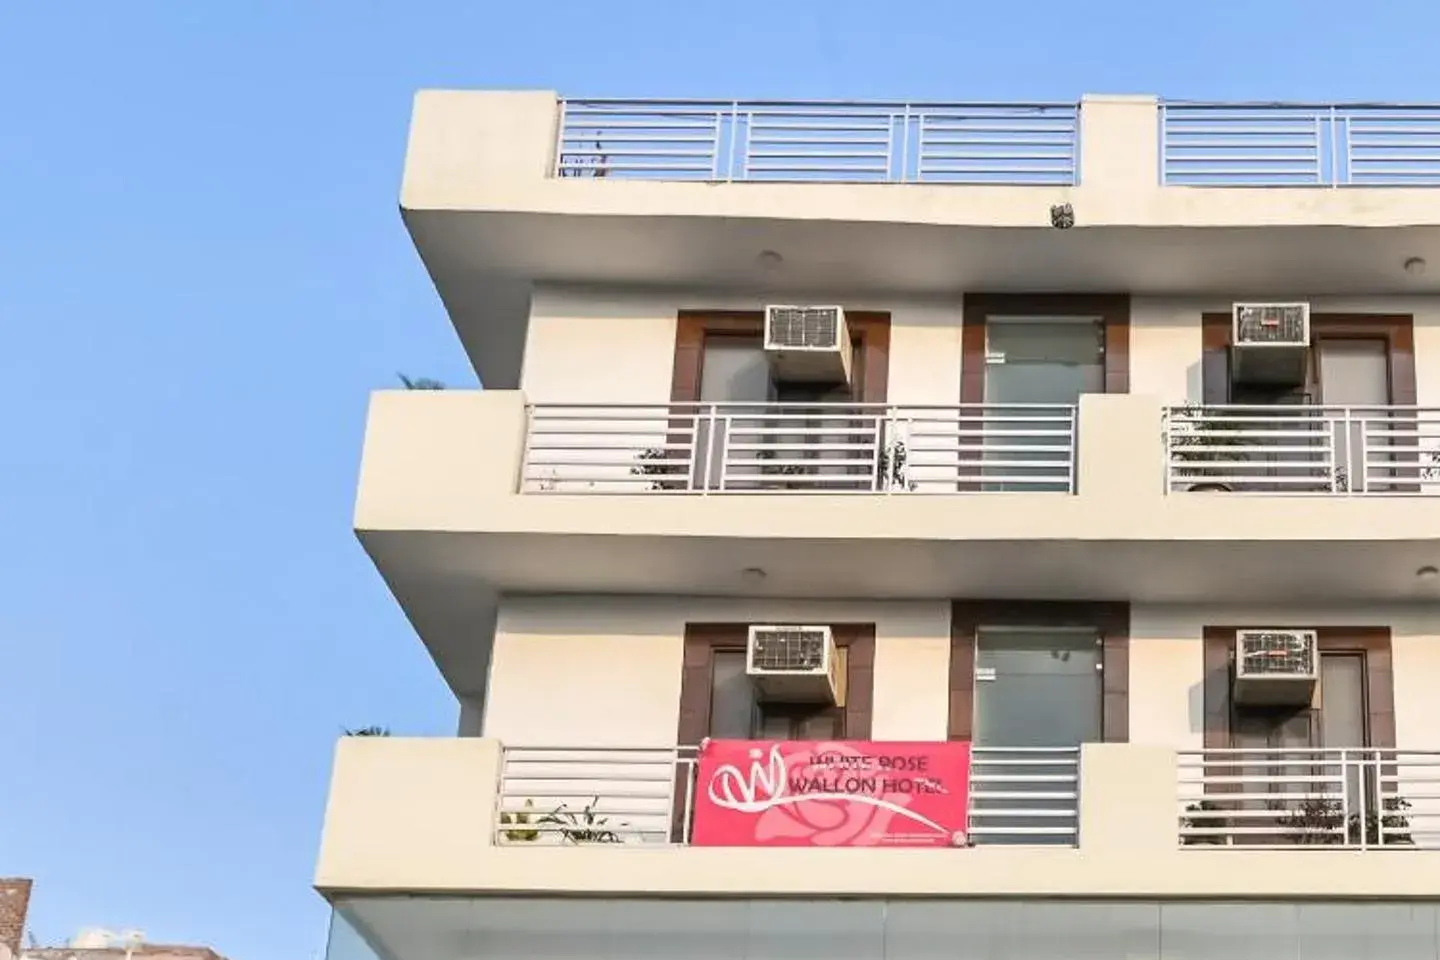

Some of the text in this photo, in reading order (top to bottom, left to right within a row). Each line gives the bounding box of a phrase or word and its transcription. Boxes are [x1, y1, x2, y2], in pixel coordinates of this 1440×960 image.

[878, 755, 929, 771] ROSE
[788, 777, 943, 794] WALLON HOTEL
